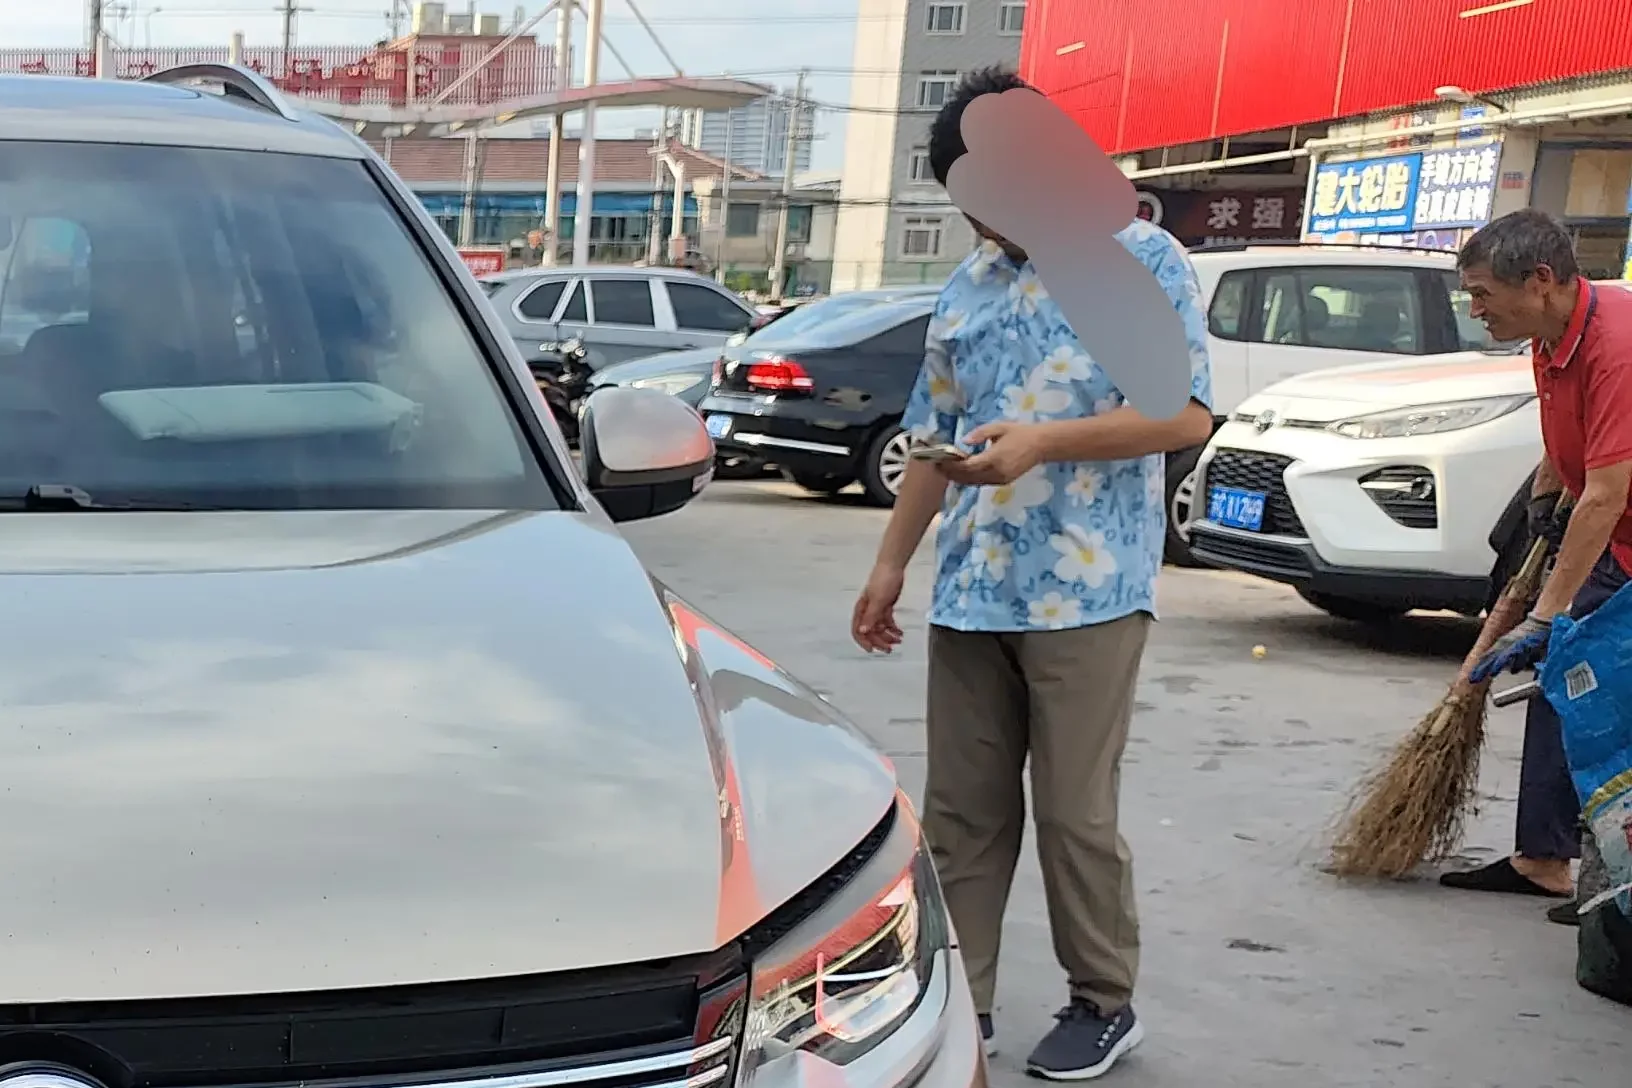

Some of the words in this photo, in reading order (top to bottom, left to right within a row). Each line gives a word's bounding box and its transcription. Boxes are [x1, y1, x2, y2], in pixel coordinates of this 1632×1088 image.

[1311, 160, 1410, 218] 建大轮胎
[1206, 196, 1306, 230] 求强
